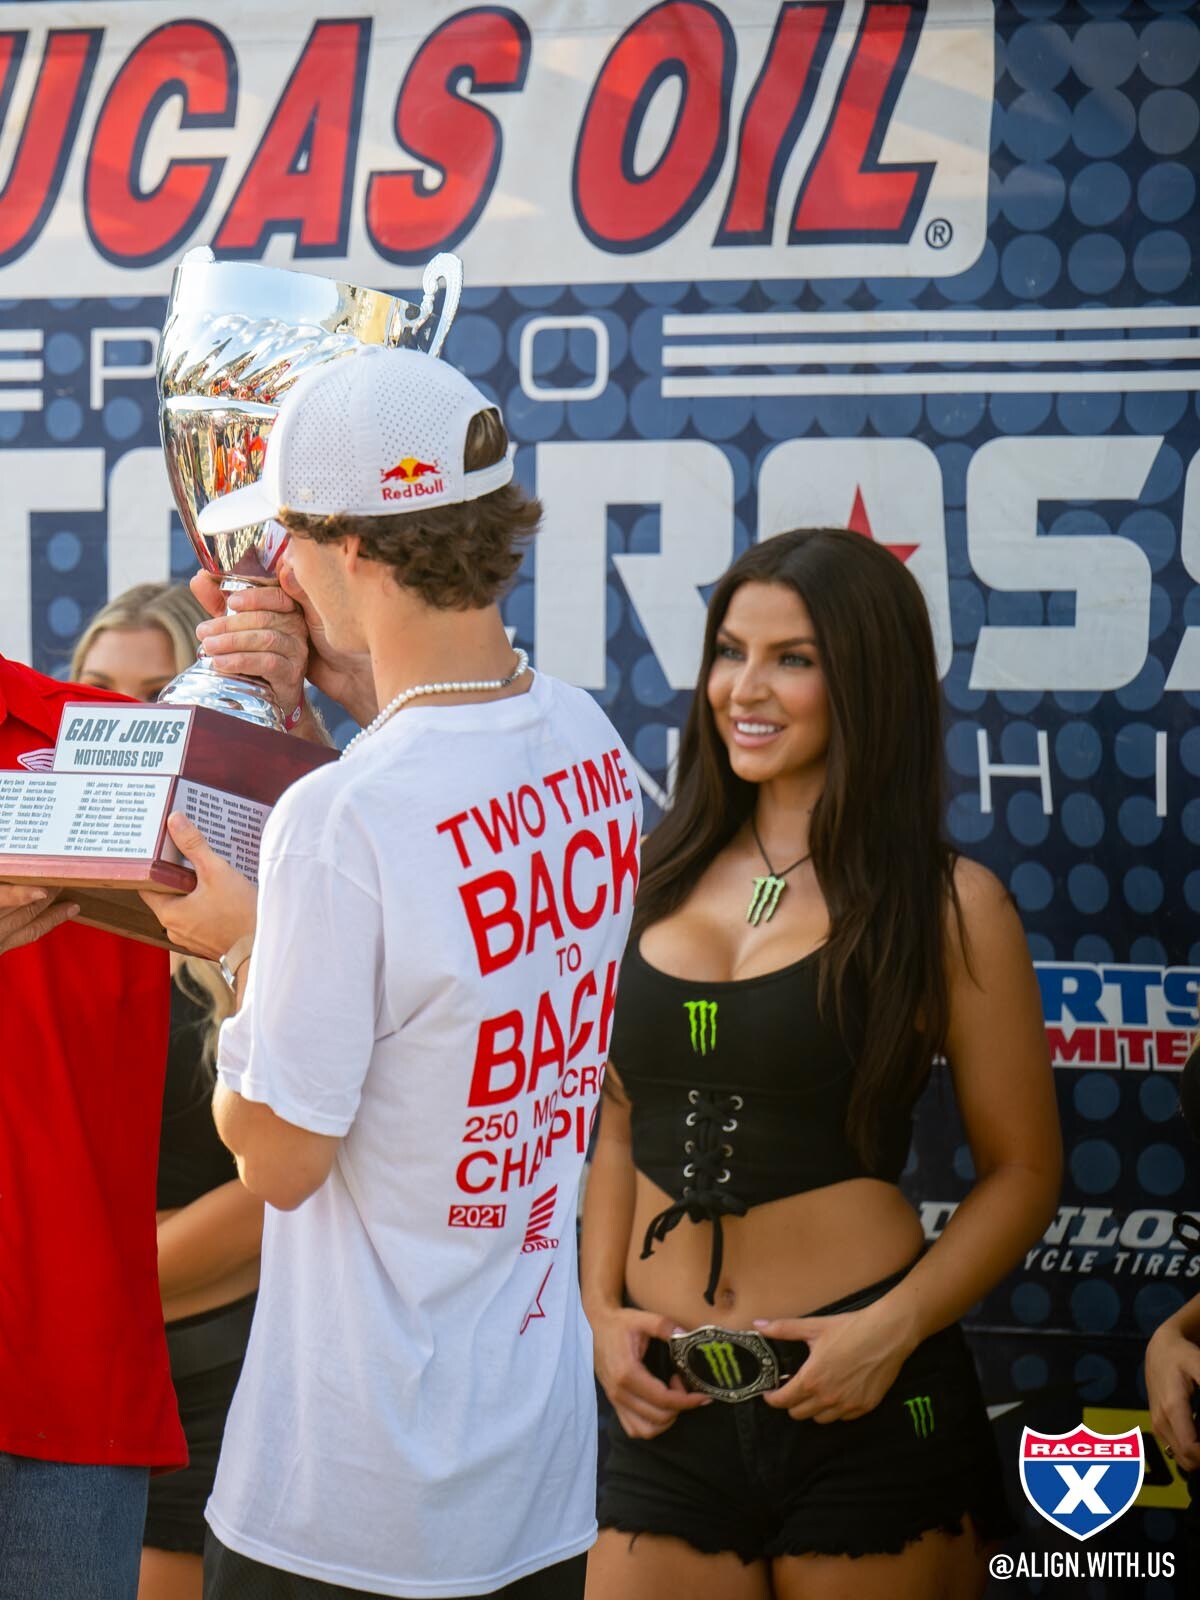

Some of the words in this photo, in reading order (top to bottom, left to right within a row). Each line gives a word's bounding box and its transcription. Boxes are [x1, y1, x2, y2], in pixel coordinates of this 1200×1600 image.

[572, 0, 937, 257] OIL
[90, 326, 610, 411] PO
[382, 484, 412, 500] Red
[414, 479, 444, 496] Bull
[65, 718, 121, 742] GARY
[118, 720, 185, 745] JONES
[73, 749, 139, 768] MOTOCROSS
[141, 751, 164, 768] CUP
[435, 784, 546, 869] TWO
[542, 748, 633, 824] TIME
[458, 811, 639, 977] BACK
[556, 943, 582, 977] TO
[1037, 966, 1200, 1027] RTS
[468, 960, 618, 1108] BACK
[462, 1110, 518, 1142] 250
[450, 1206, 504, 1227] 2021
[1113, 1252, 1200, 1278] TIRES
